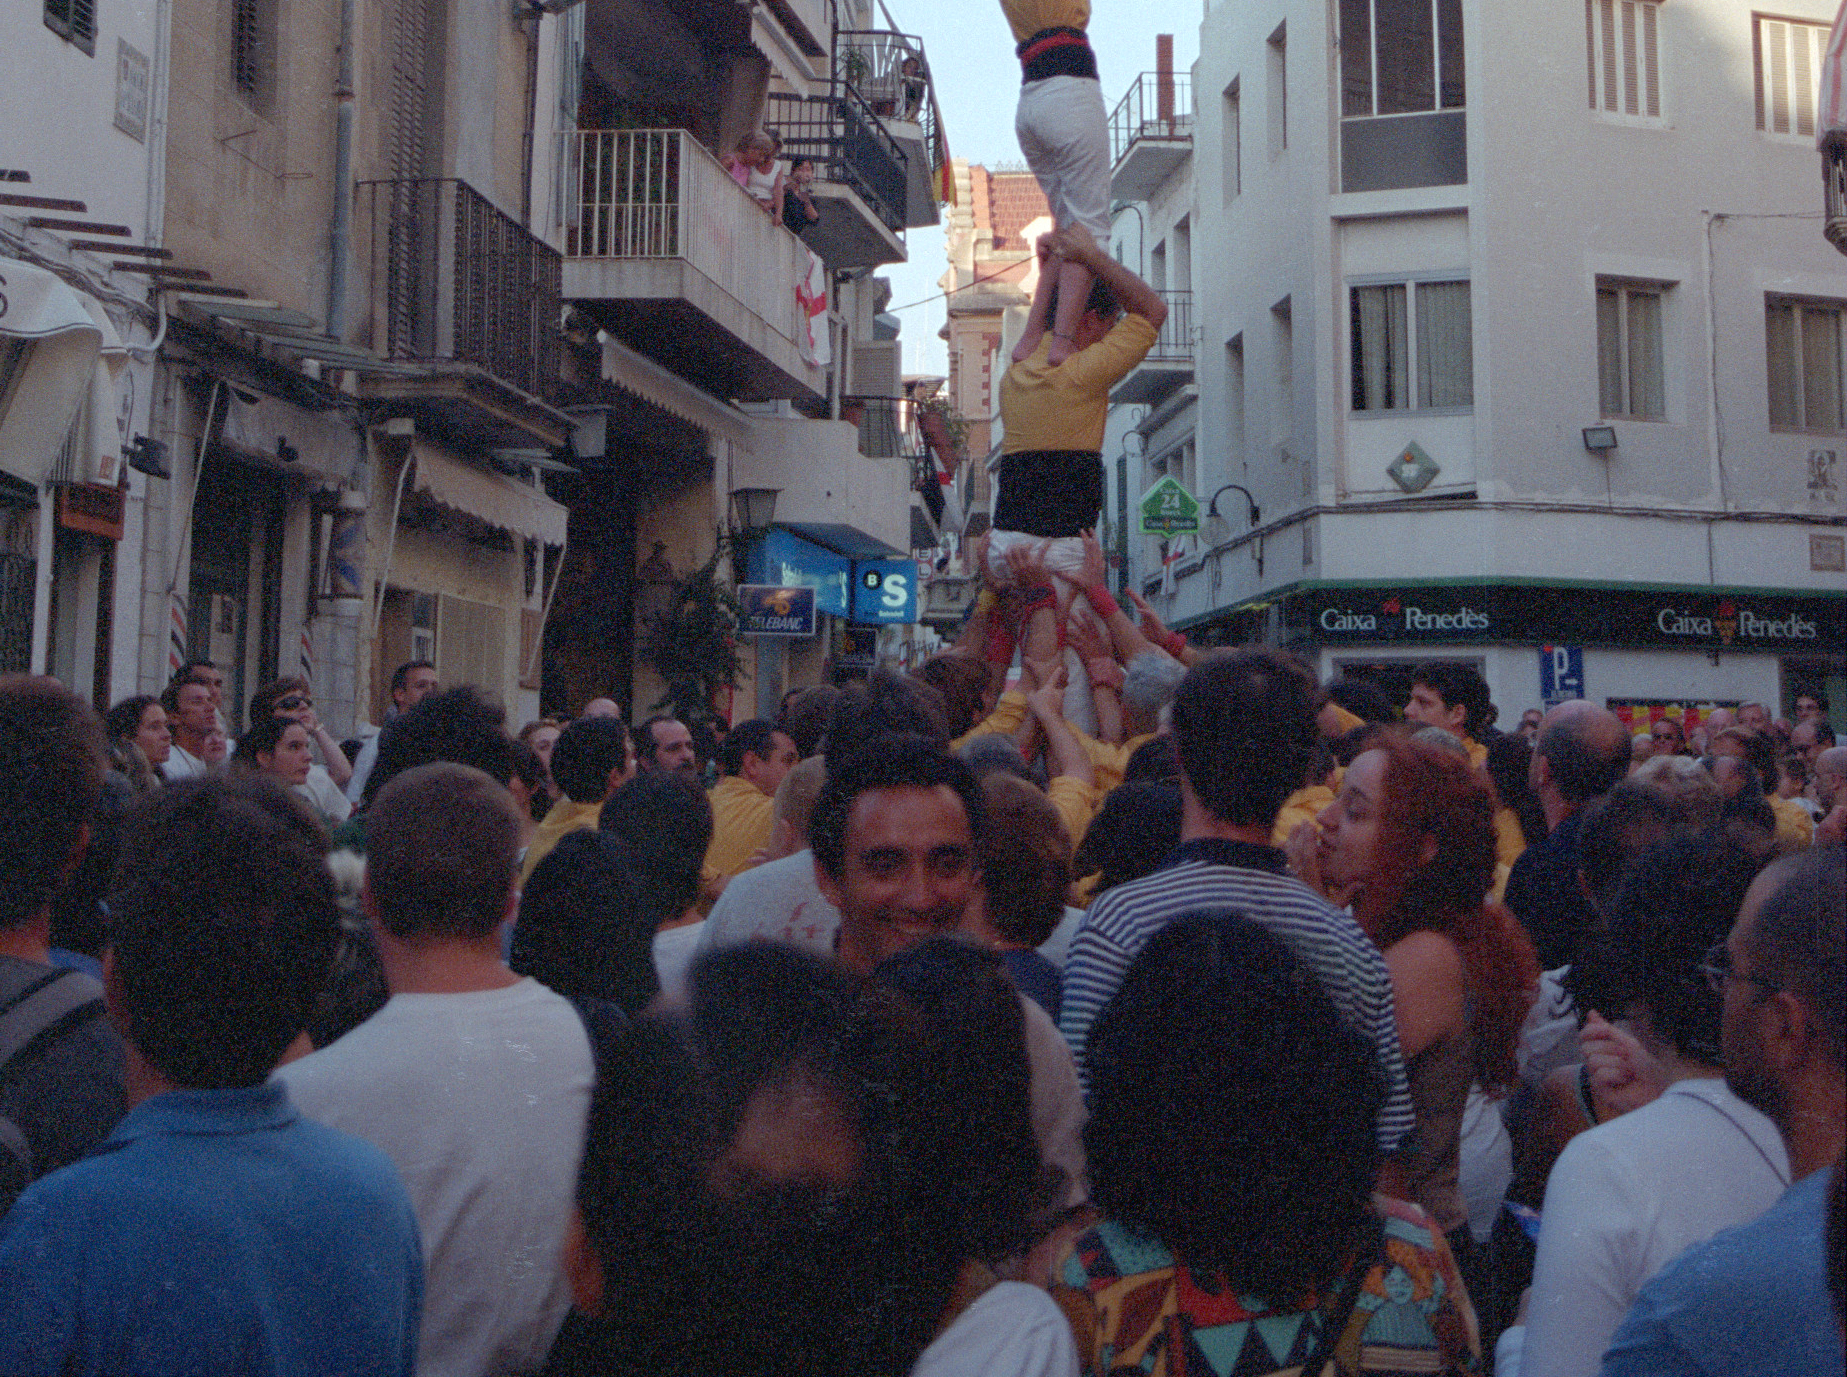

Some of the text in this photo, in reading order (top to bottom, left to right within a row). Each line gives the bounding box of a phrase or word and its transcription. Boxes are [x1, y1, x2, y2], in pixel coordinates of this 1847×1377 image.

[1162, 494, 1180, 509] 24
[1319, 607, 1490, 630] Caixa Penedès
[1658, 608, 1817, 638] Caixa Penedès
[1553, 646, 1569, 690] P
